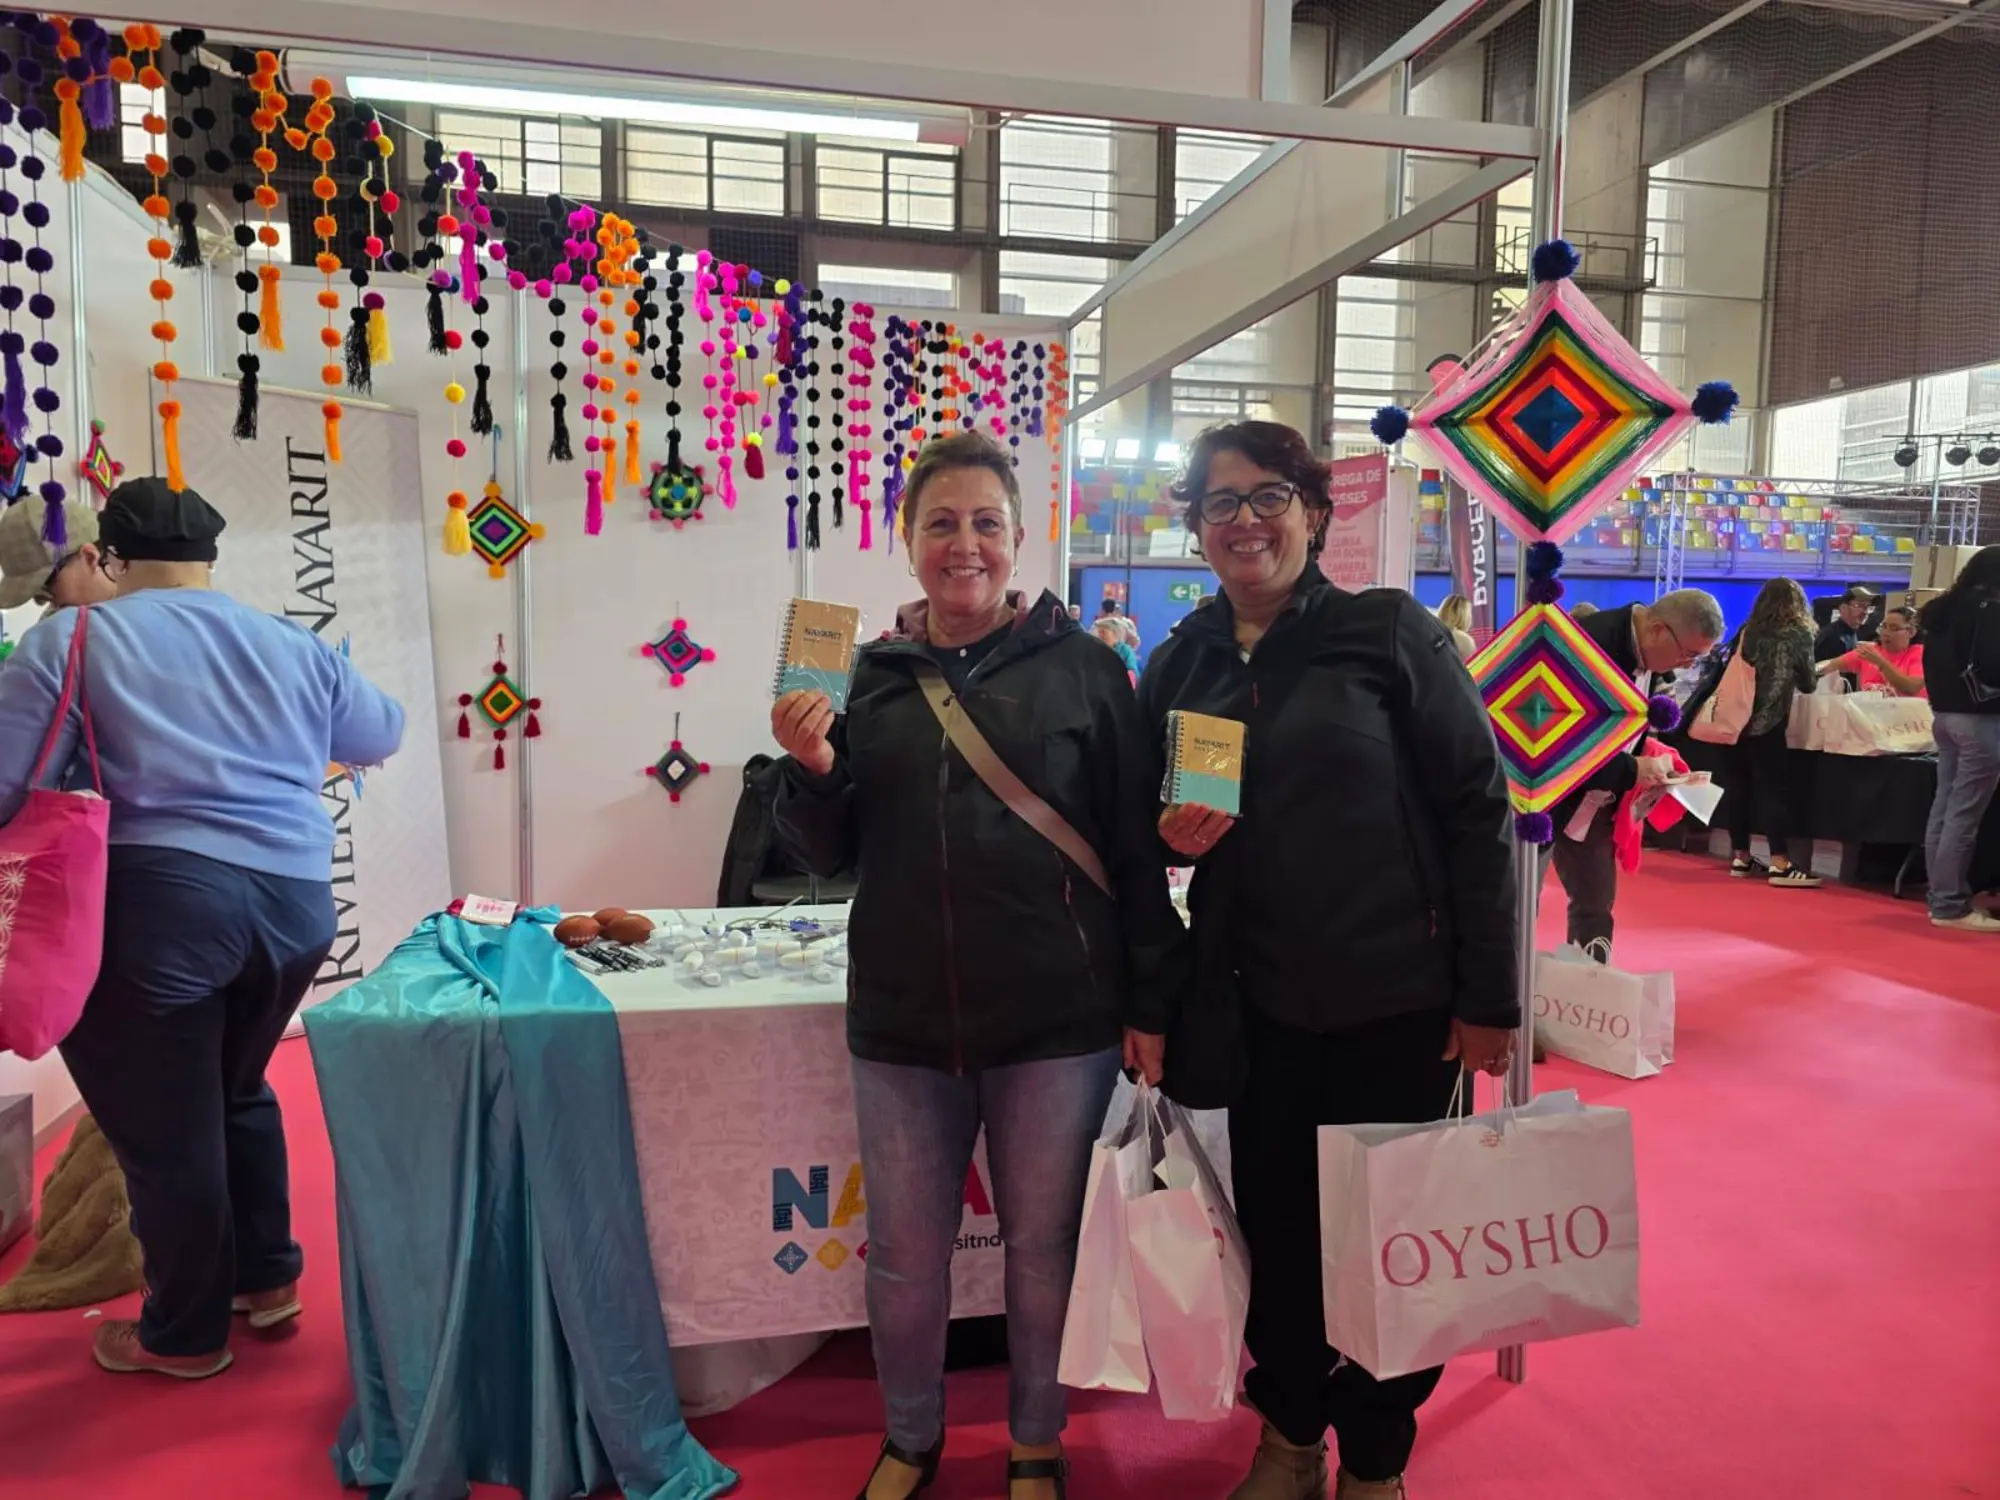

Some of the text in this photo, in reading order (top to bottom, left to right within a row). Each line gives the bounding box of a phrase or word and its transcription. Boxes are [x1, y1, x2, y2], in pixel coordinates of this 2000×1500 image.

[1366, 468, 1382, 483] DE
[283, 435, 337, 634] NAYARIT
[1533, 995, 1630, 1039] OYSHO
[1381, 1204, 1610, 1287] OYSHO
